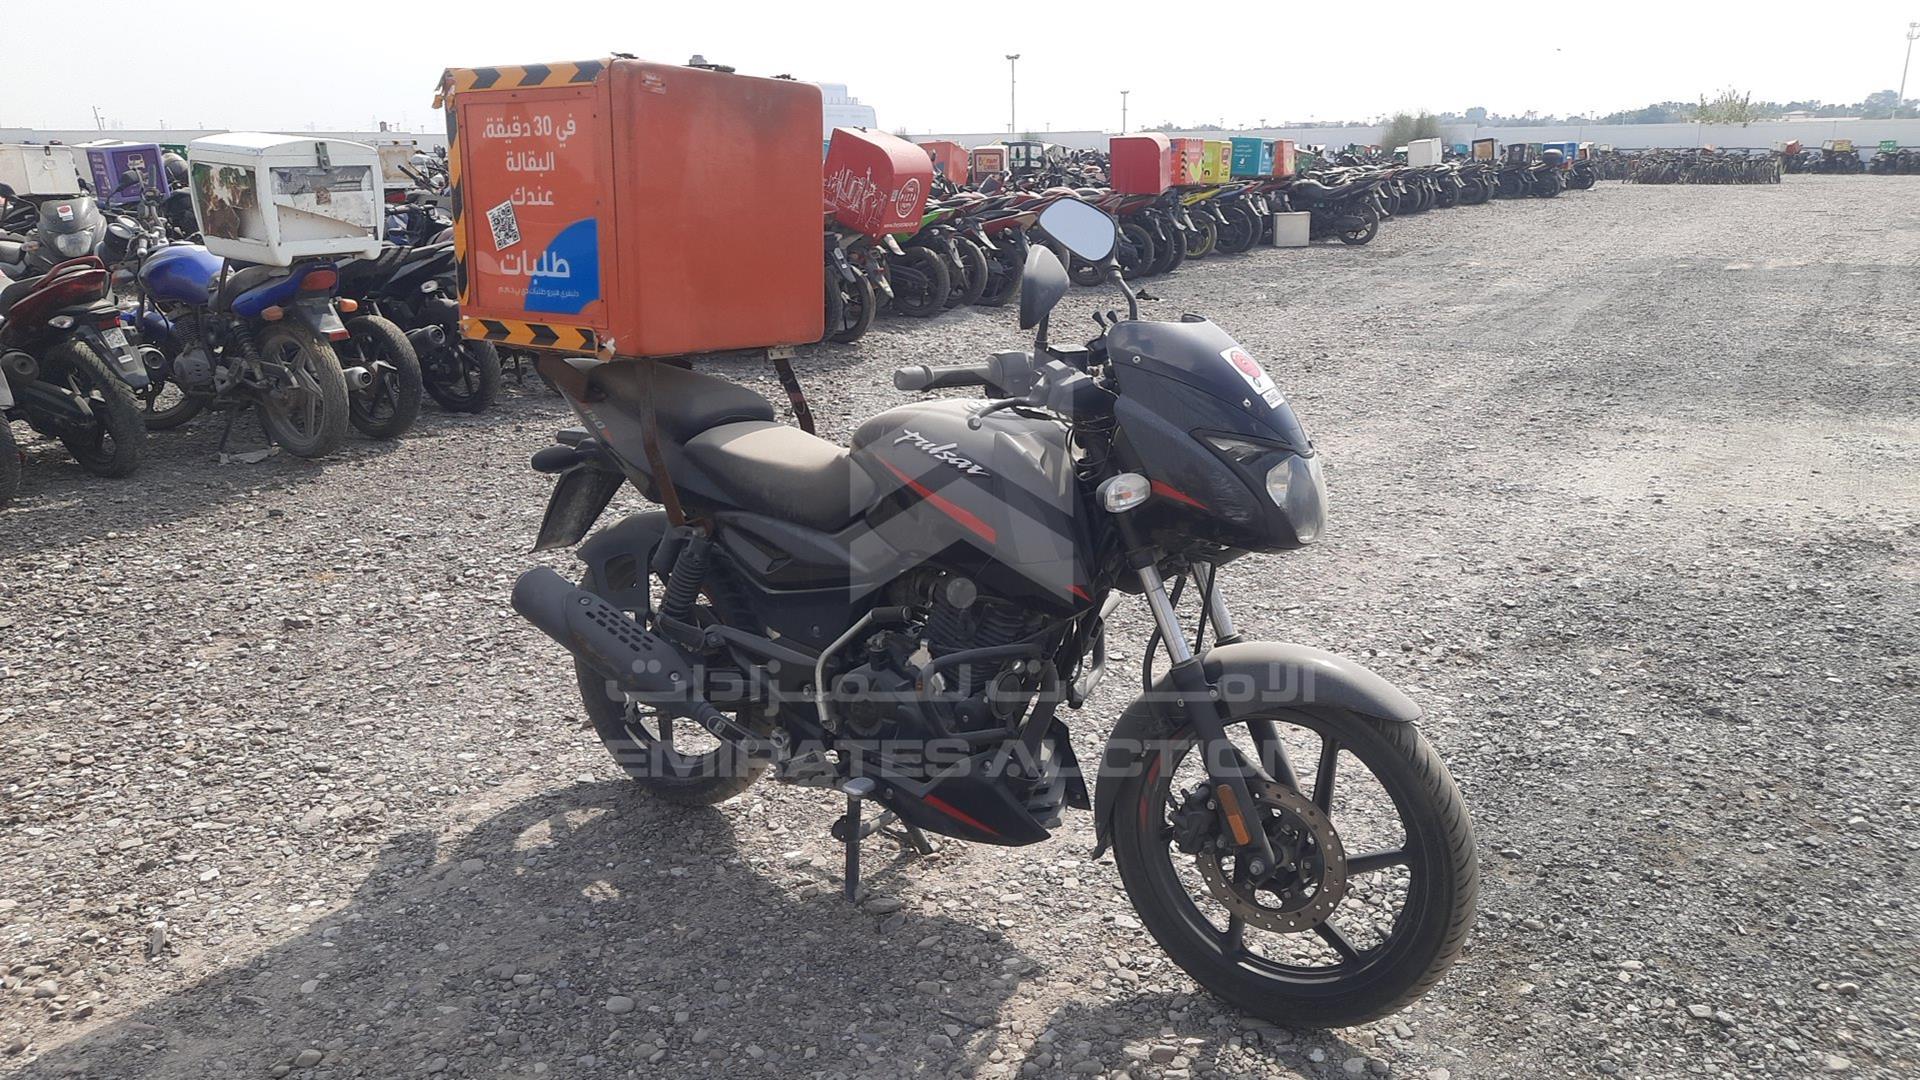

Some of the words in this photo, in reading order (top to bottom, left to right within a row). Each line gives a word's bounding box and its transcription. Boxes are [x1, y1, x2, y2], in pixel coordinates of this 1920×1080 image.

[533, 115, 553, 136] 30
[556, 113, 577, 148] في
[506, 150, 556, 178] البقالة
[510, 185, 555, 206] عندك
[500, 249, 571, 286] طلبات
